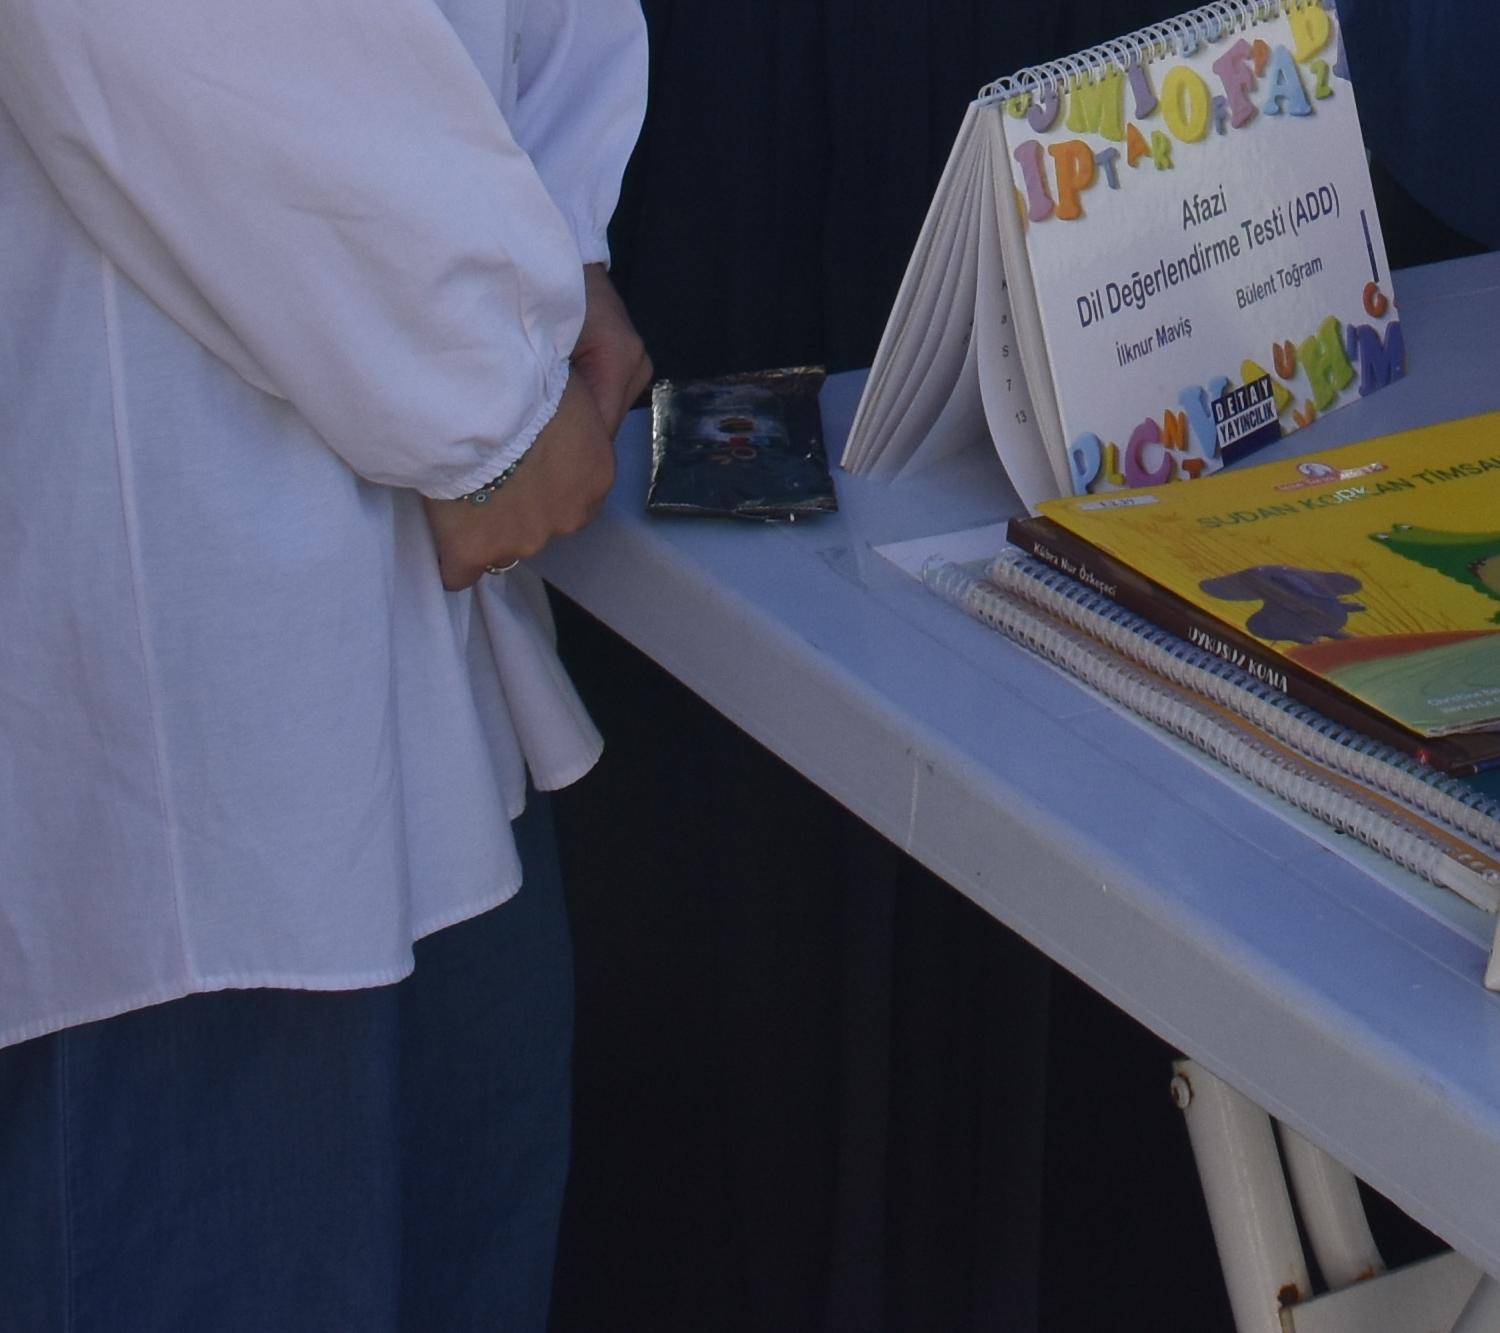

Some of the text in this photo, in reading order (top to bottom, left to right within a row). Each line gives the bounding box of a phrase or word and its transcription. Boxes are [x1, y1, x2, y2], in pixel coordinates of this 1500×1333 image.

[1182, 184, 1228, 231] Afazi
[1076, 182, 1341, 328] Dil Değerlendirme Testi (ADD)
[1235, 256, 1324, 310] Bülent Toğram
[1115, 316, 1193, 367] İlknur Maviş
[1015, 410, 1028, 425] 13
[1214, 376, 1272, 421] DETAY
[1217, 404, 1276, 444] YAYINCILIK
[1196, 501, 1299, 529] SUDAN
[1033, 541, 1117, 598] Kübra Nur Özkeçeci
[1187, 626, 1289, 694] UYKUSUZ KOALA
